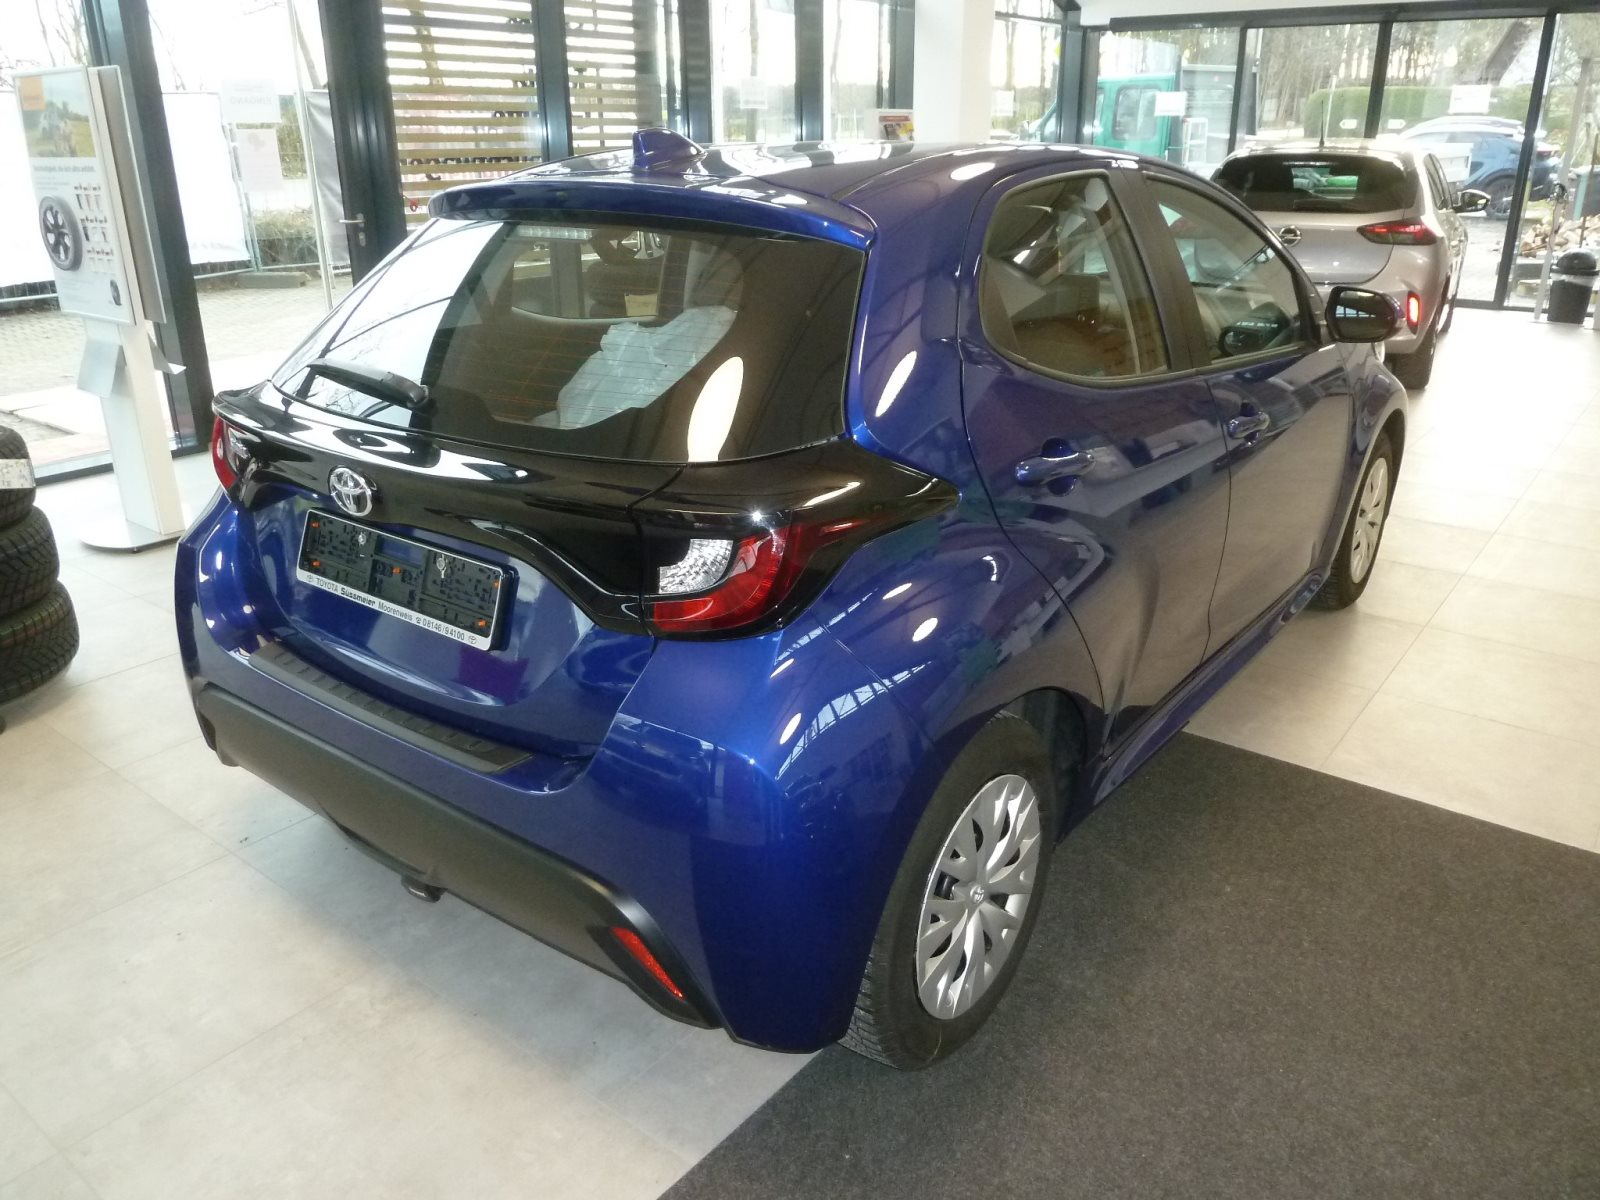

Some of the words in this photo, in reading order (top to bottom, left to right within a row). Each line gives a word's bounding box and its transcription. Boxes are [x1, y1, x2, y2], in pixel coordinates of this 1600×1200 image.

[316, 577, 339, 593] TOYOTA
[378, 601, 413, 621] Moorenweis
[422, 618, 465, 641] 08146/94100
